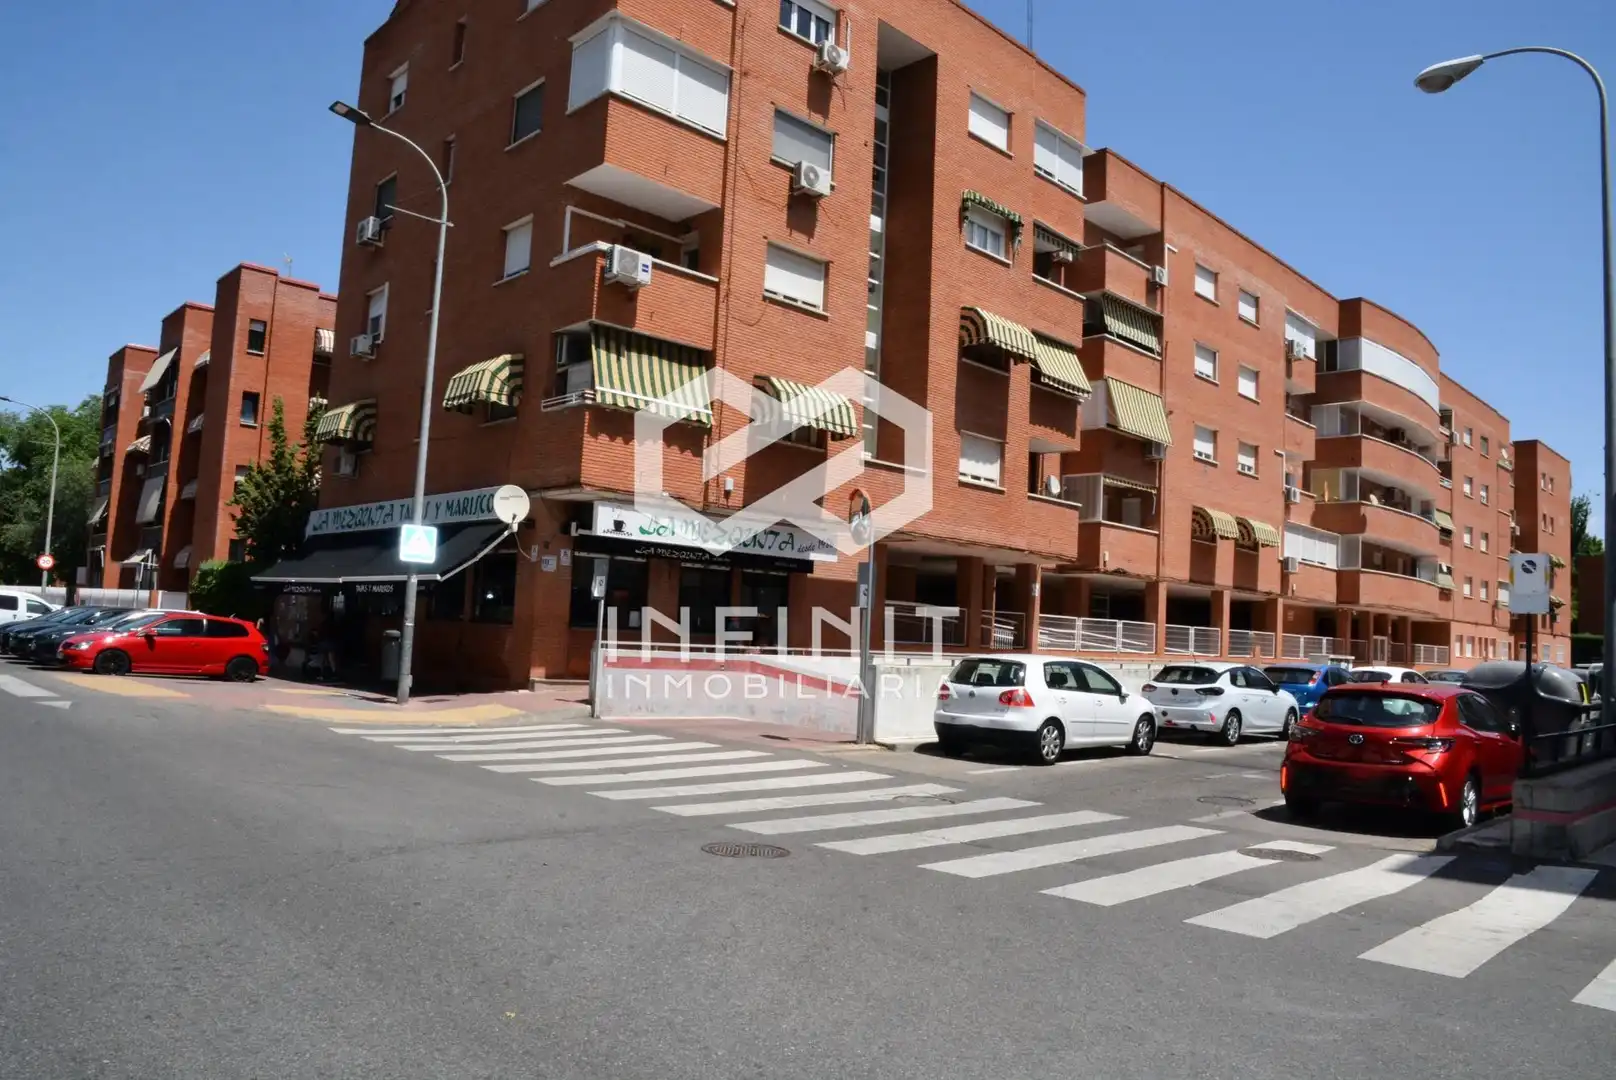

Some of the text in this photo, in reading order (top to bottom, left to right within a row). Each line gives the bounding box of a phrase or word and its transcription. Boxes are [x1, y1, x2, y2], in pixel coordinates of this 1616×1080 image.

[400, 501, 431, 521] TAS
[435, 501, 442, 519] Y
[446, 494, 495, 517] MARISCO
[639, 516, 676, 536] LA
